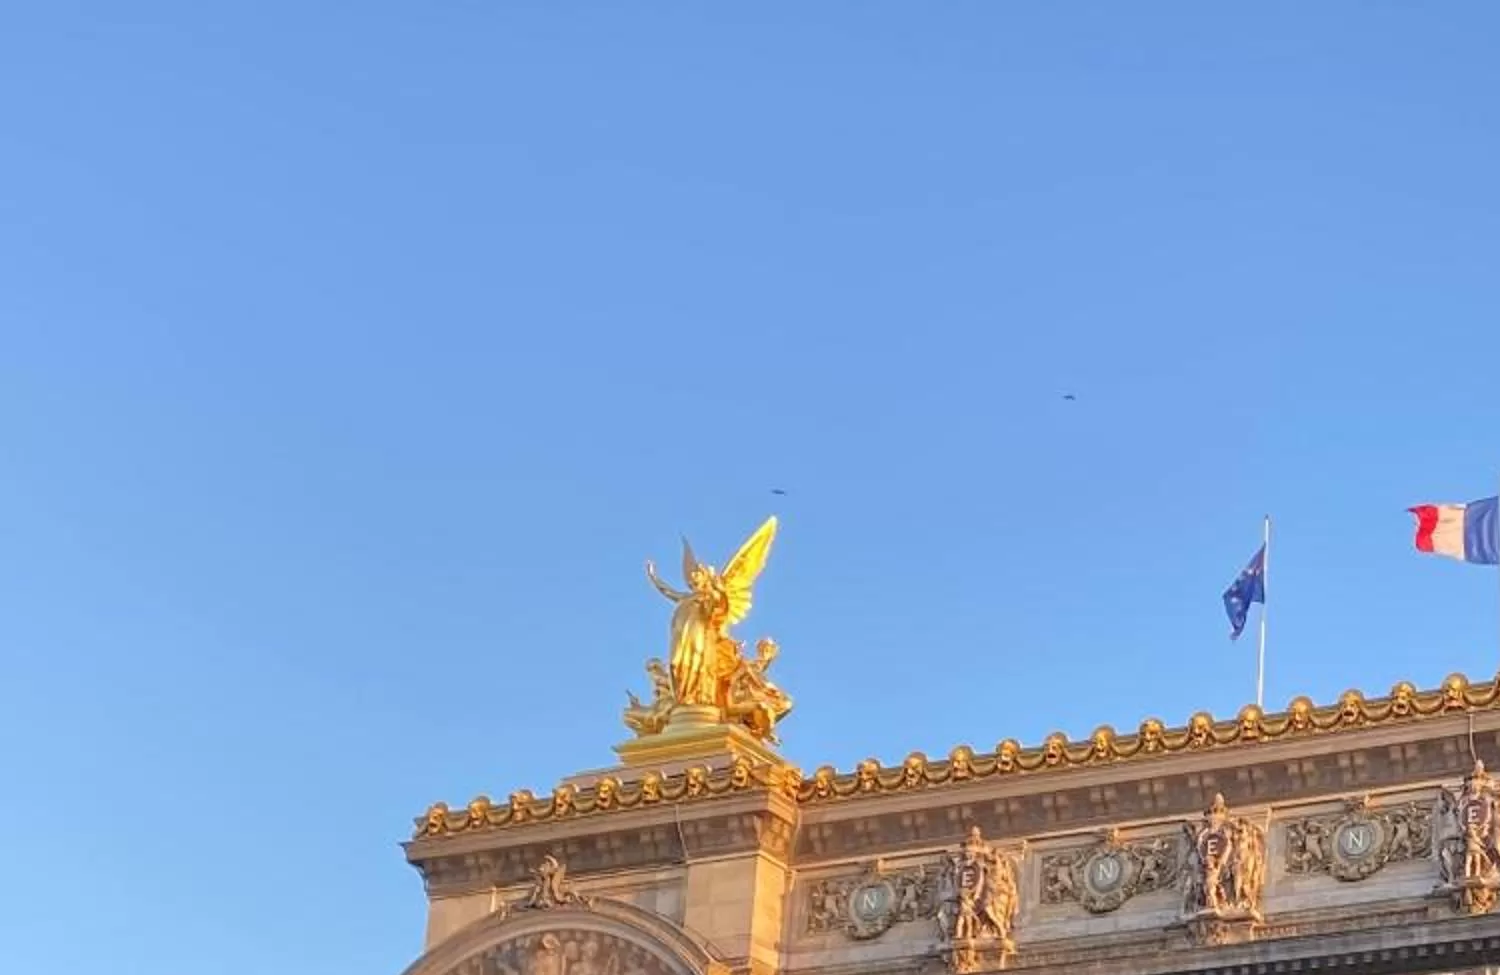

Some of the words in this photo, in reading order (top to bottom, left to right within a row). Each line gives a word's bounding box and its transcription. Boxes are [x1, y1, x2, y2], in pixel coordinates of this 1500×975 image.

[1468, 807, 1478, 822] E
[1208, 840, 1218, 855] E
[1349, 831, 1363, 848] N
[963, 871, 973, 887] E
[1099, 862, 1112, 880] N
[864, 891, 877, 909] N
